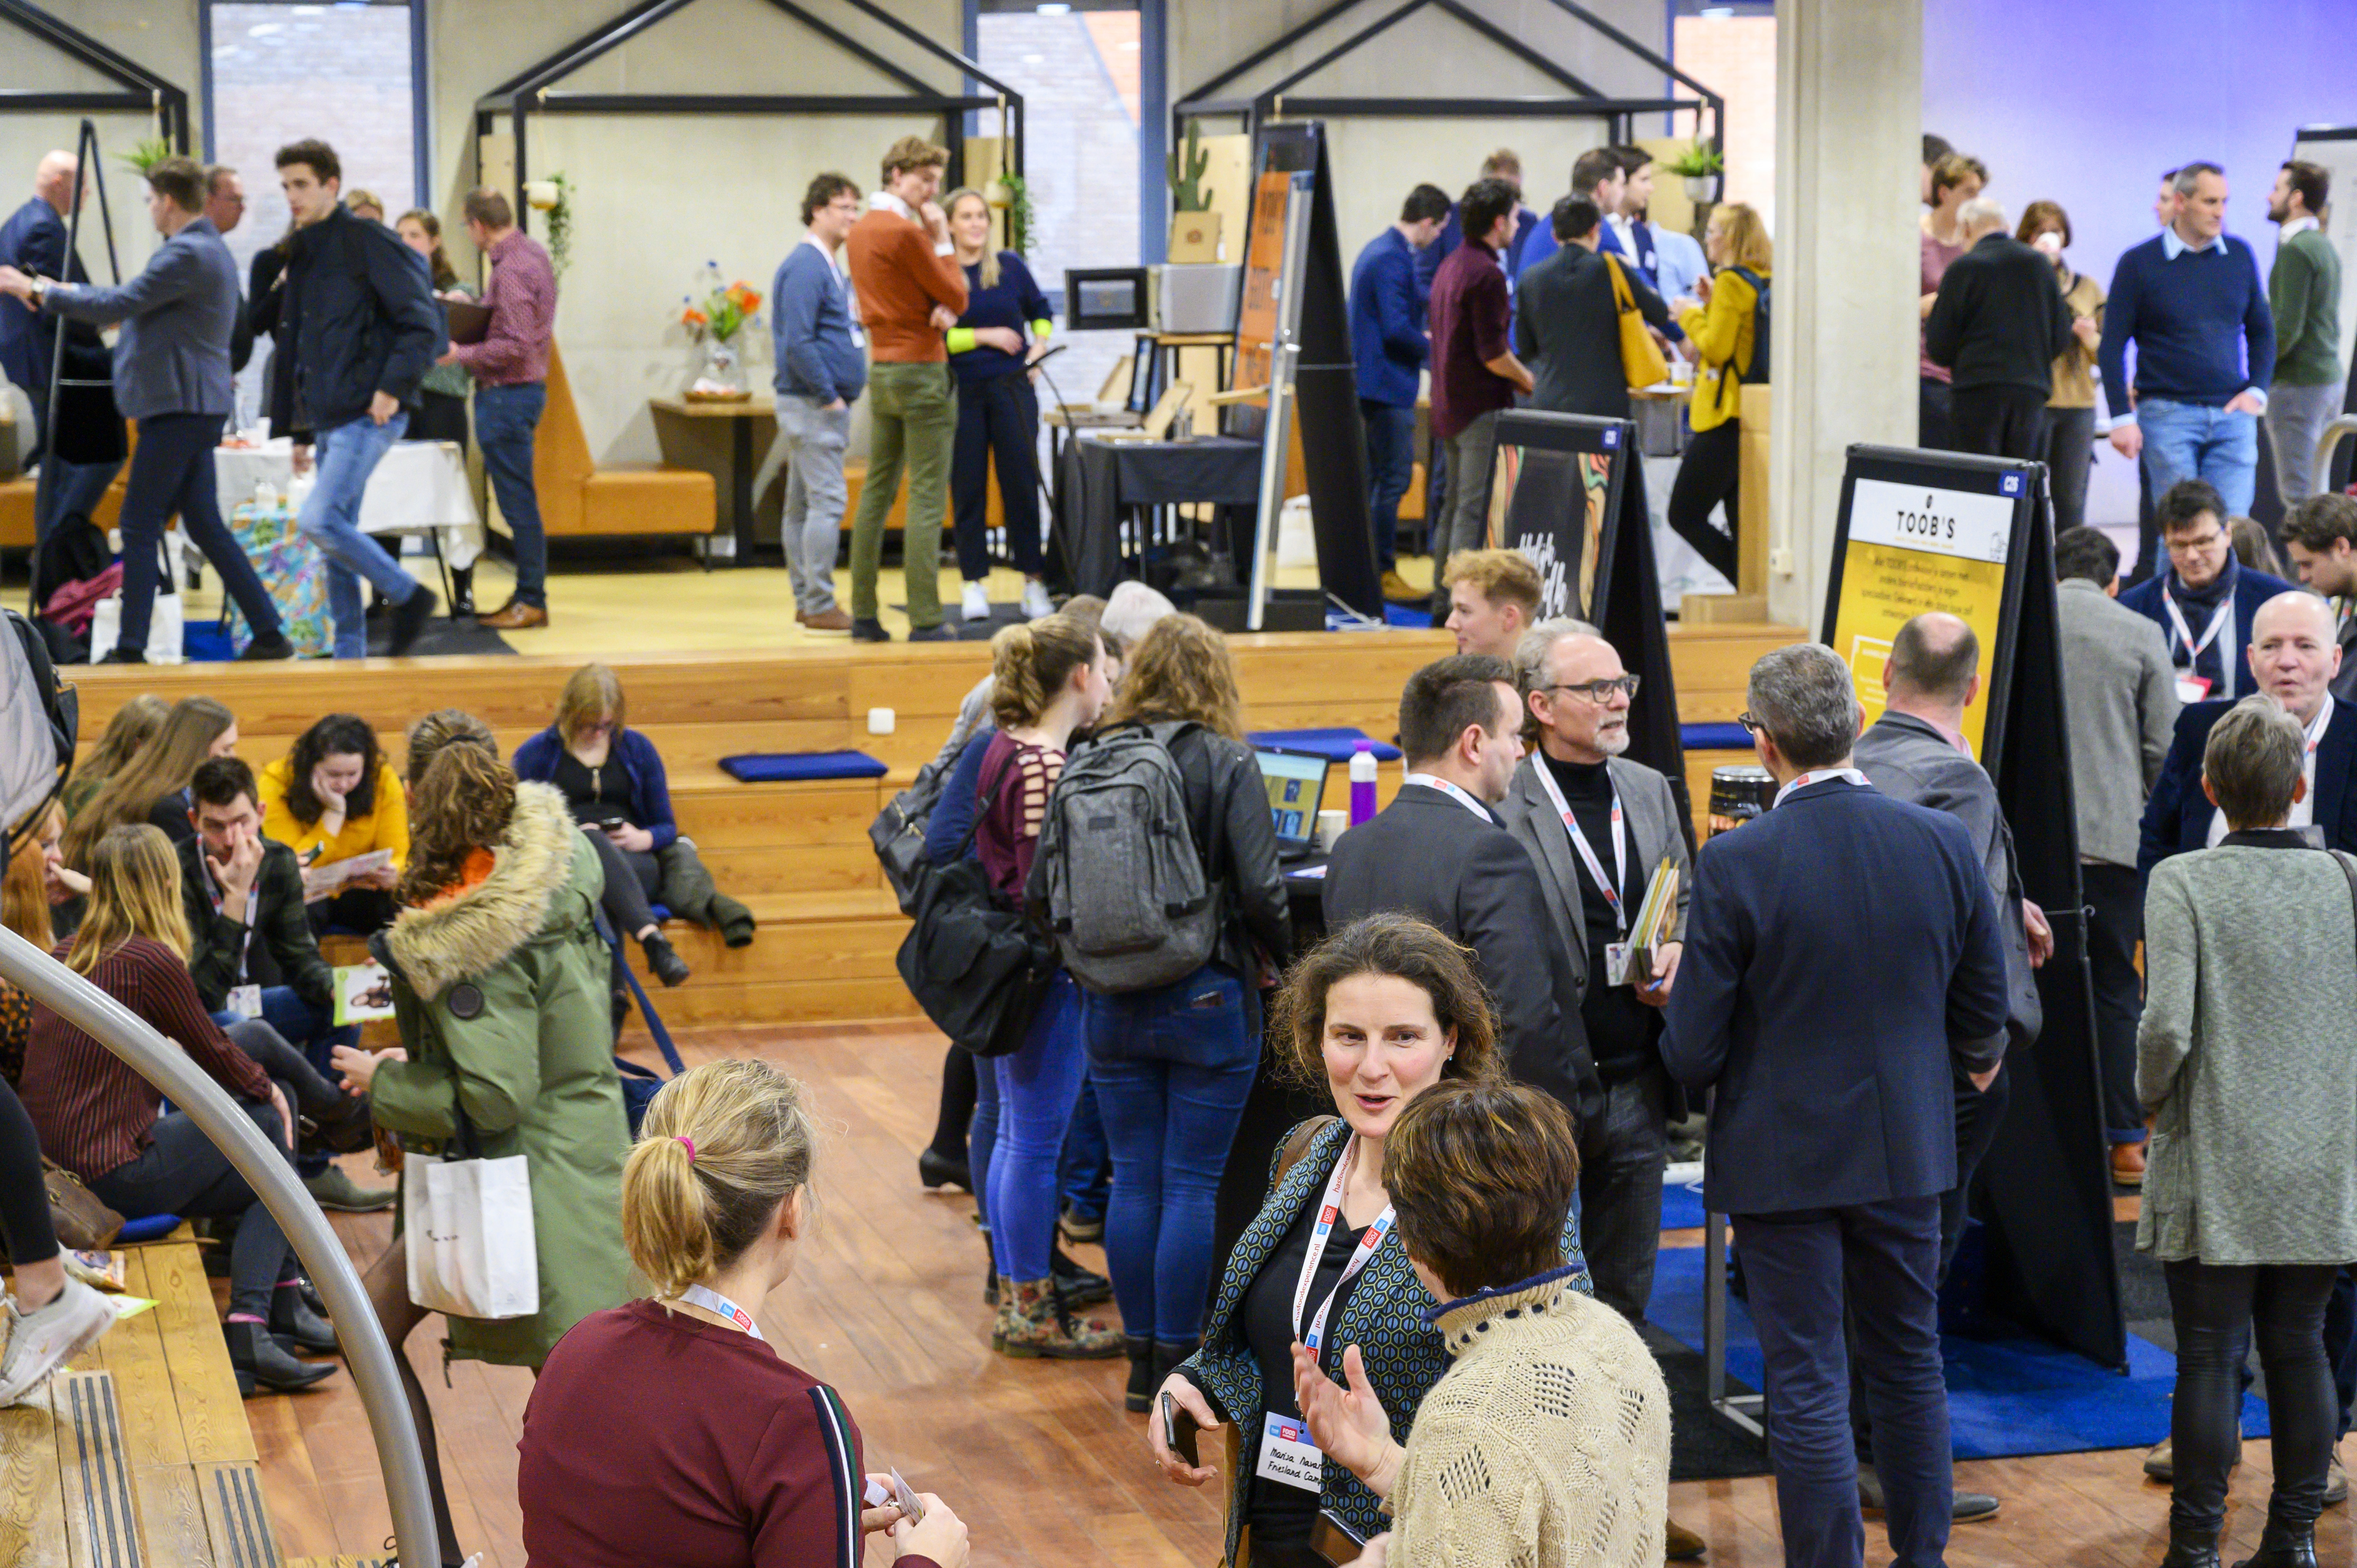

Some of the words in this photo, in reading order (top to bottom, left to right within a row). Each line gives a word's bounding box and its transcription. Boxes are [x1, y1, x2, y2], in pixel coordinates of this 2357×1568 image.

[1897, 511, 1955, 539] TOOB'S
[1323, 1207, 1332, 1222] FOOD
[1366, 1231, 1378, 1246] FOOD
[1295, 1244, 1321, 1321] hasfoodexperience.nl
[737, 1311, 751, 1326] FOOD
[1282, 1428, 1296, 1436] FOOD
[1267, 1461, 1300, 1478] Friesland
